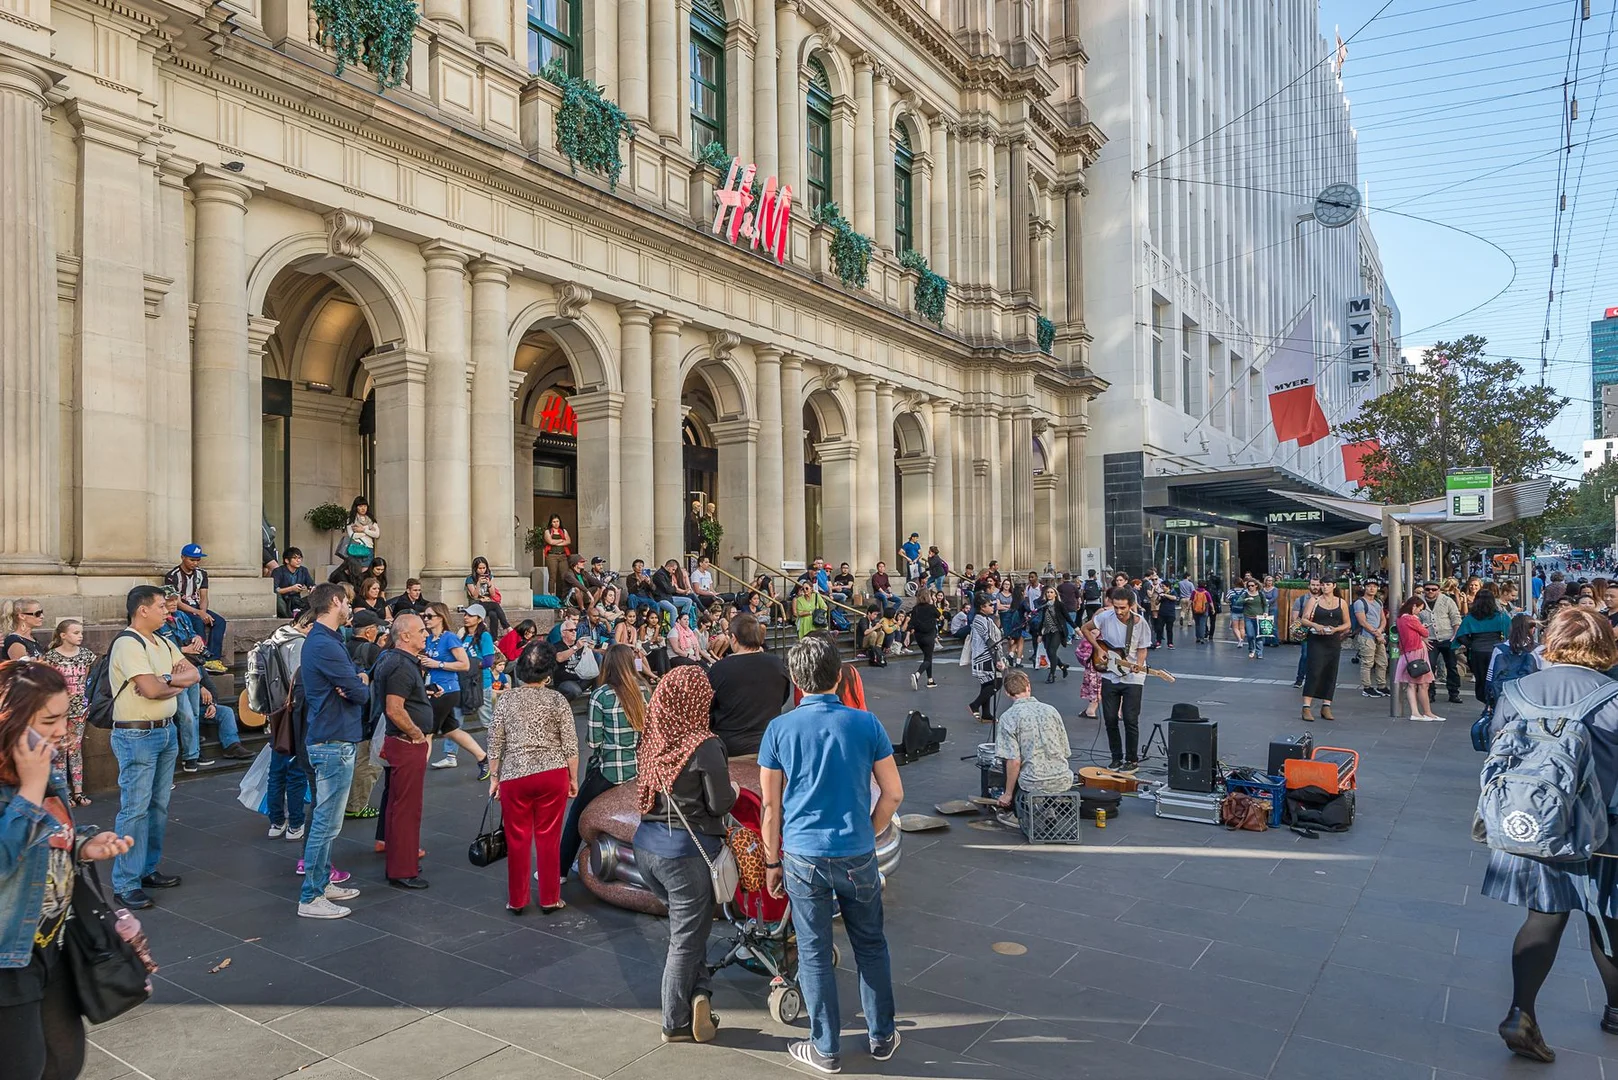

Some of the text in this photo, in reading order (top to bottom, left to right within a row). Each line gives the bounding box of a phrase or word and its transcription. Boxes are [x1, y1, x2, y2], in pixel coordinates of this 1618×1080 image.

[712, 156, 792, 265] H&M
[1350, 298, 1371, 383] MYER
[1275, 378, 1309, 391] MYER
[1269, 510, 1321, 522] MYER
